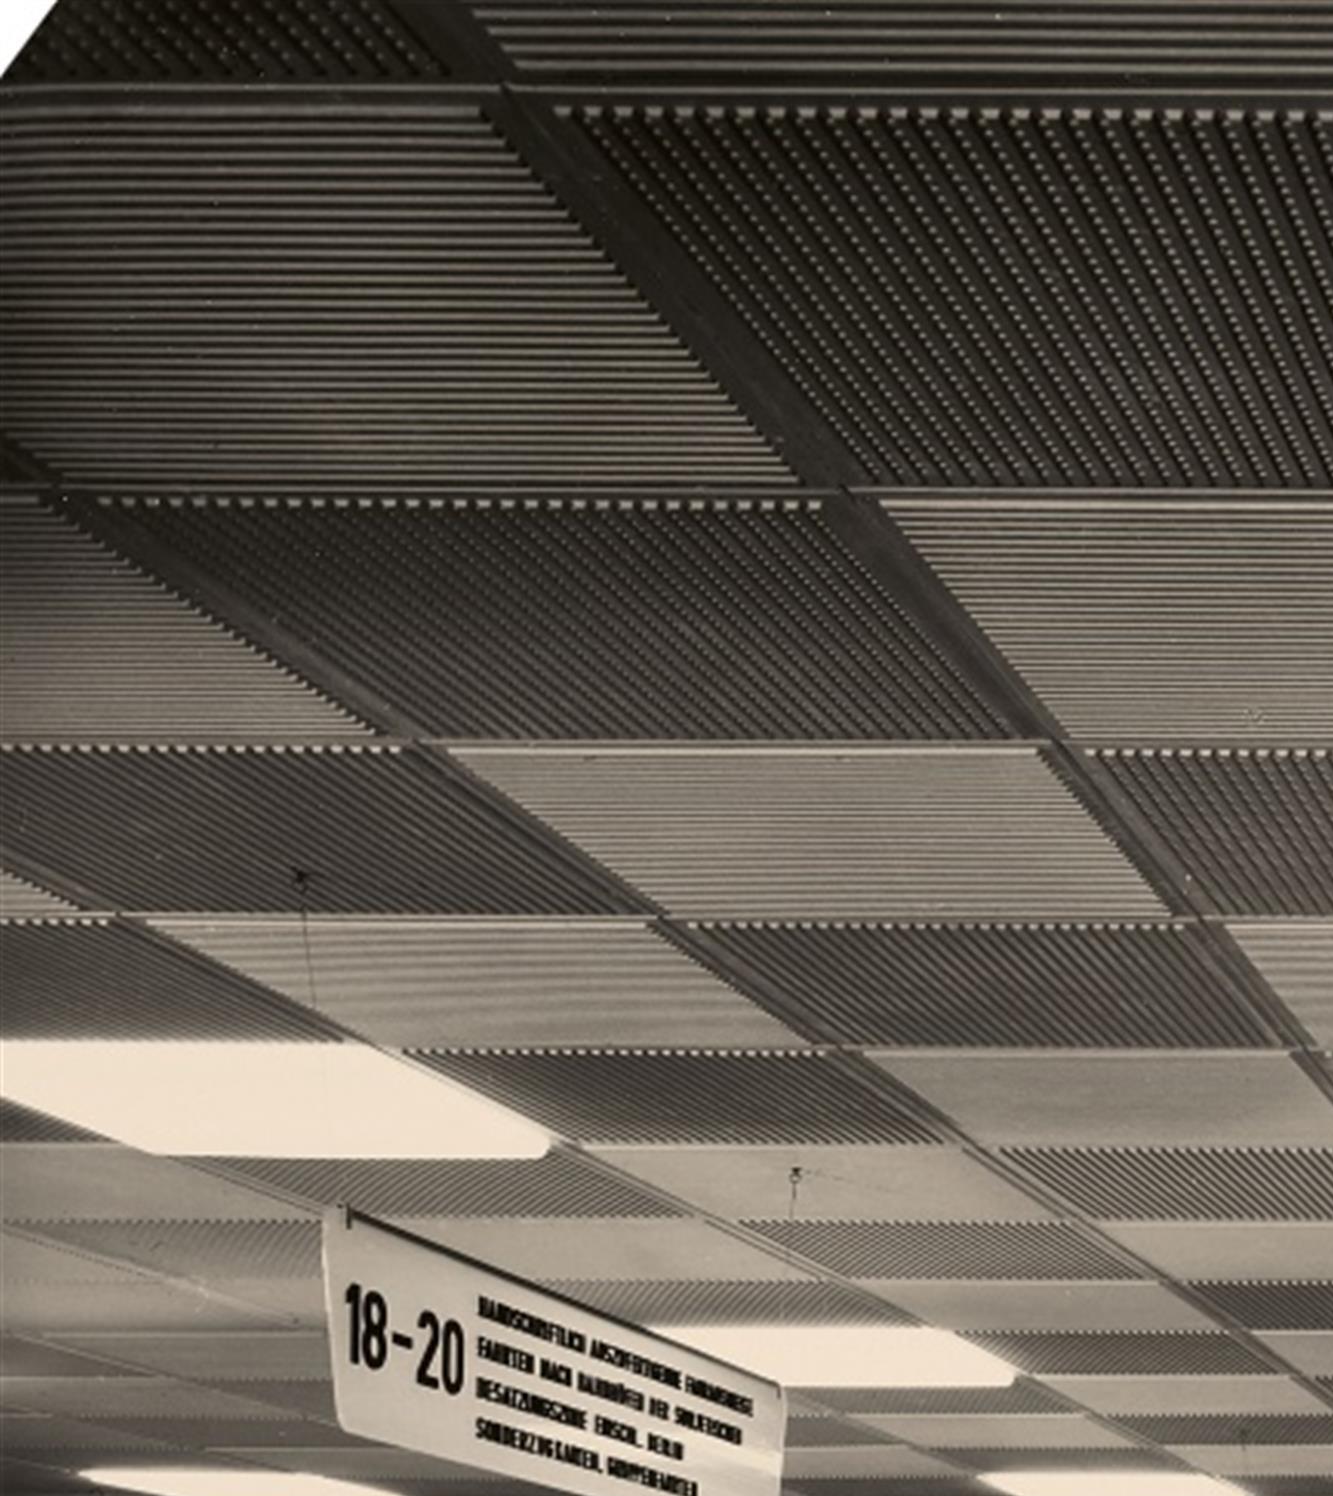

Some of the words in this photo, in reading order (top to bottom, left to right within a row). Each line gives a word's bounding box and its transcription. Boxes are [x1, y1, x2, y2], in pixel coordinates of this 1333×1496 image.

[344, 1283, 465, 1396] 18-20
[477, 1336, 535, 1375] FAHRTEN
[539, 1358, 572, 1388] NACH
